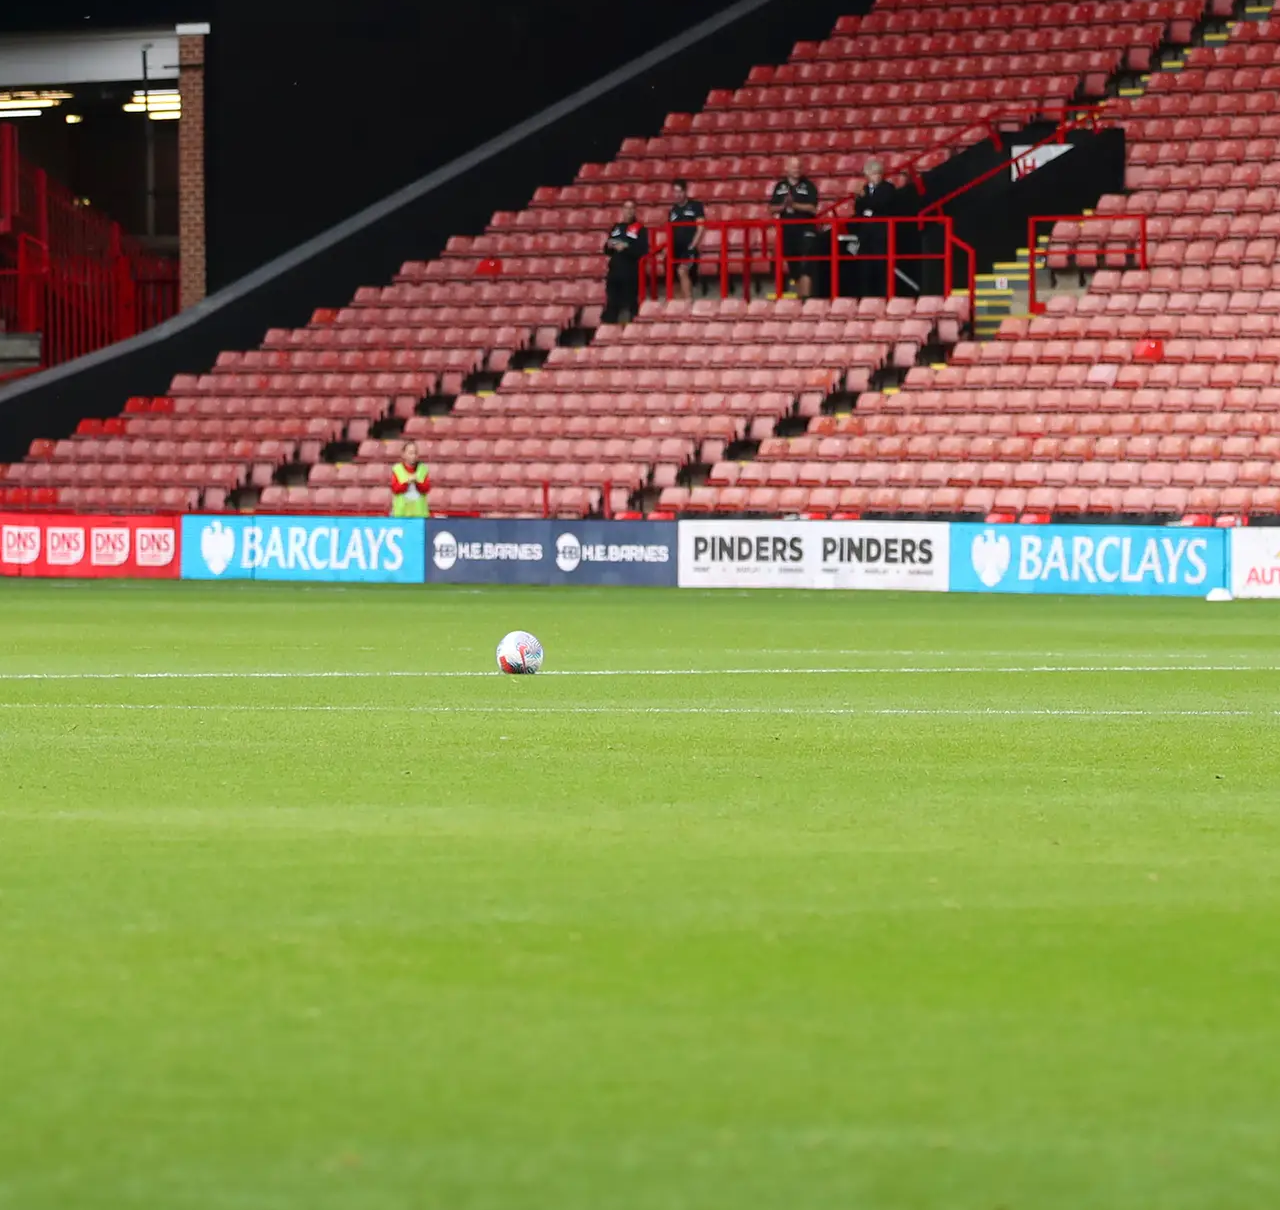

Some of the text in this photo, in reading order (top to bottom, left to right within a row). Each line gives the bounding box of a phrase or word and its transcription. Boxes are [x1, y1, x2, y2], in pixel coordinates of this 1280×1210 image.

[6, 530, 36, 550] DNS
[50, 532, 80, 551] DNS
[95, 533, 125, 552] DNS
[139, 533, 171, 552] DNS
[241, 523, 404, 572] BARCLAYS
[693, 536, 804, 562] PINDERS
[457, 542, 543, 561] H.E.BARNES
[581, 544, 669, 563] H.E.BARNES
[822, 537, 933, 564] PINDERS
[1019, 536, 1207, 585] BARCLAYS
